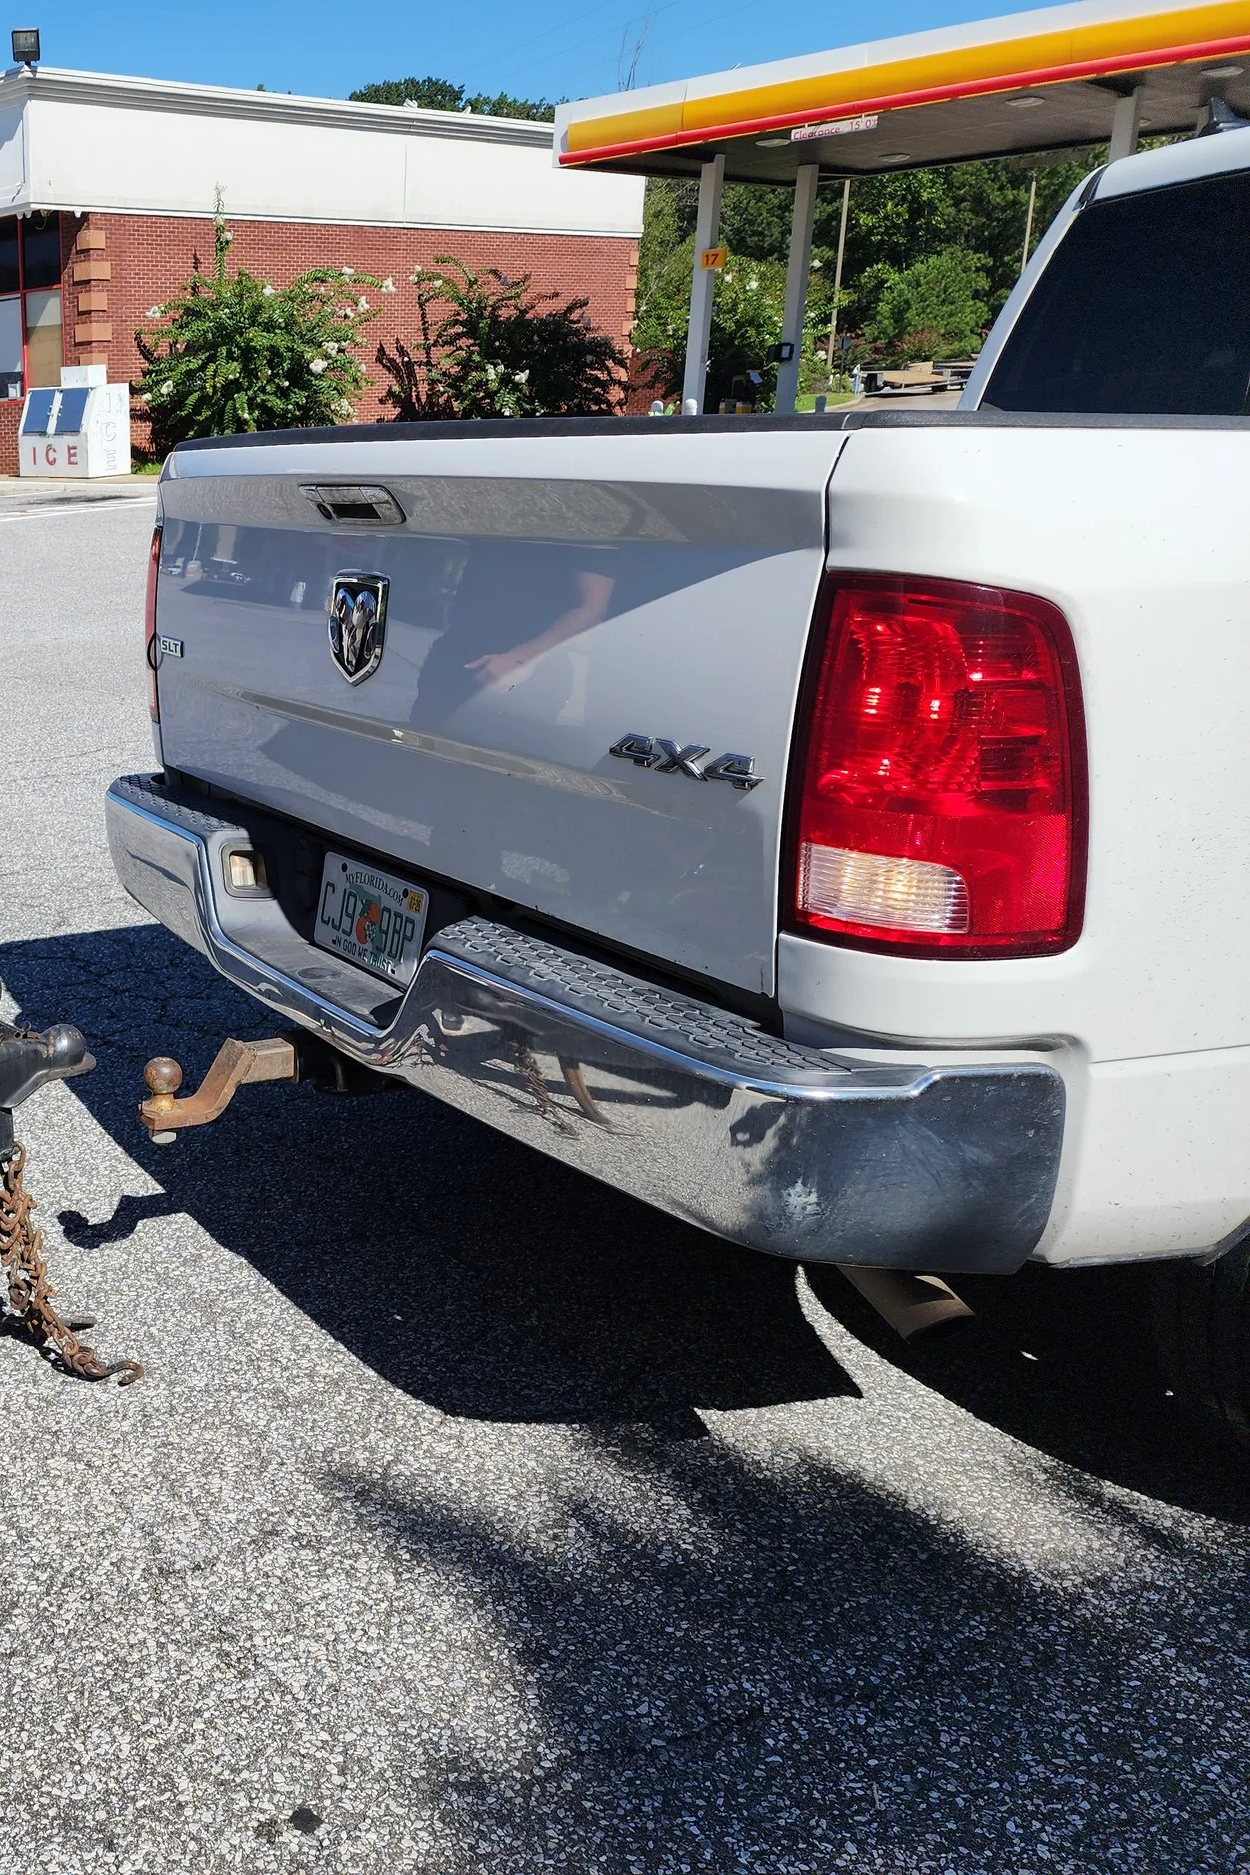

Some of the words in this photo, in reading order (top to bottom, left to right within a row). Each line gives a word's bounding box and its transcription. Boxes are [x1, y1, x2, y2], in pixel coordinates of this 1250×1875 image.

[793, 126, 841, 139] Clearance
[704, 253, 720, 265] 17
[32, 443, 79, 466] ICE
[161, 639, 180, 654] SLT
[320, 880, 359, 938] CJ9
[343, 938, 357, 956] GOD
